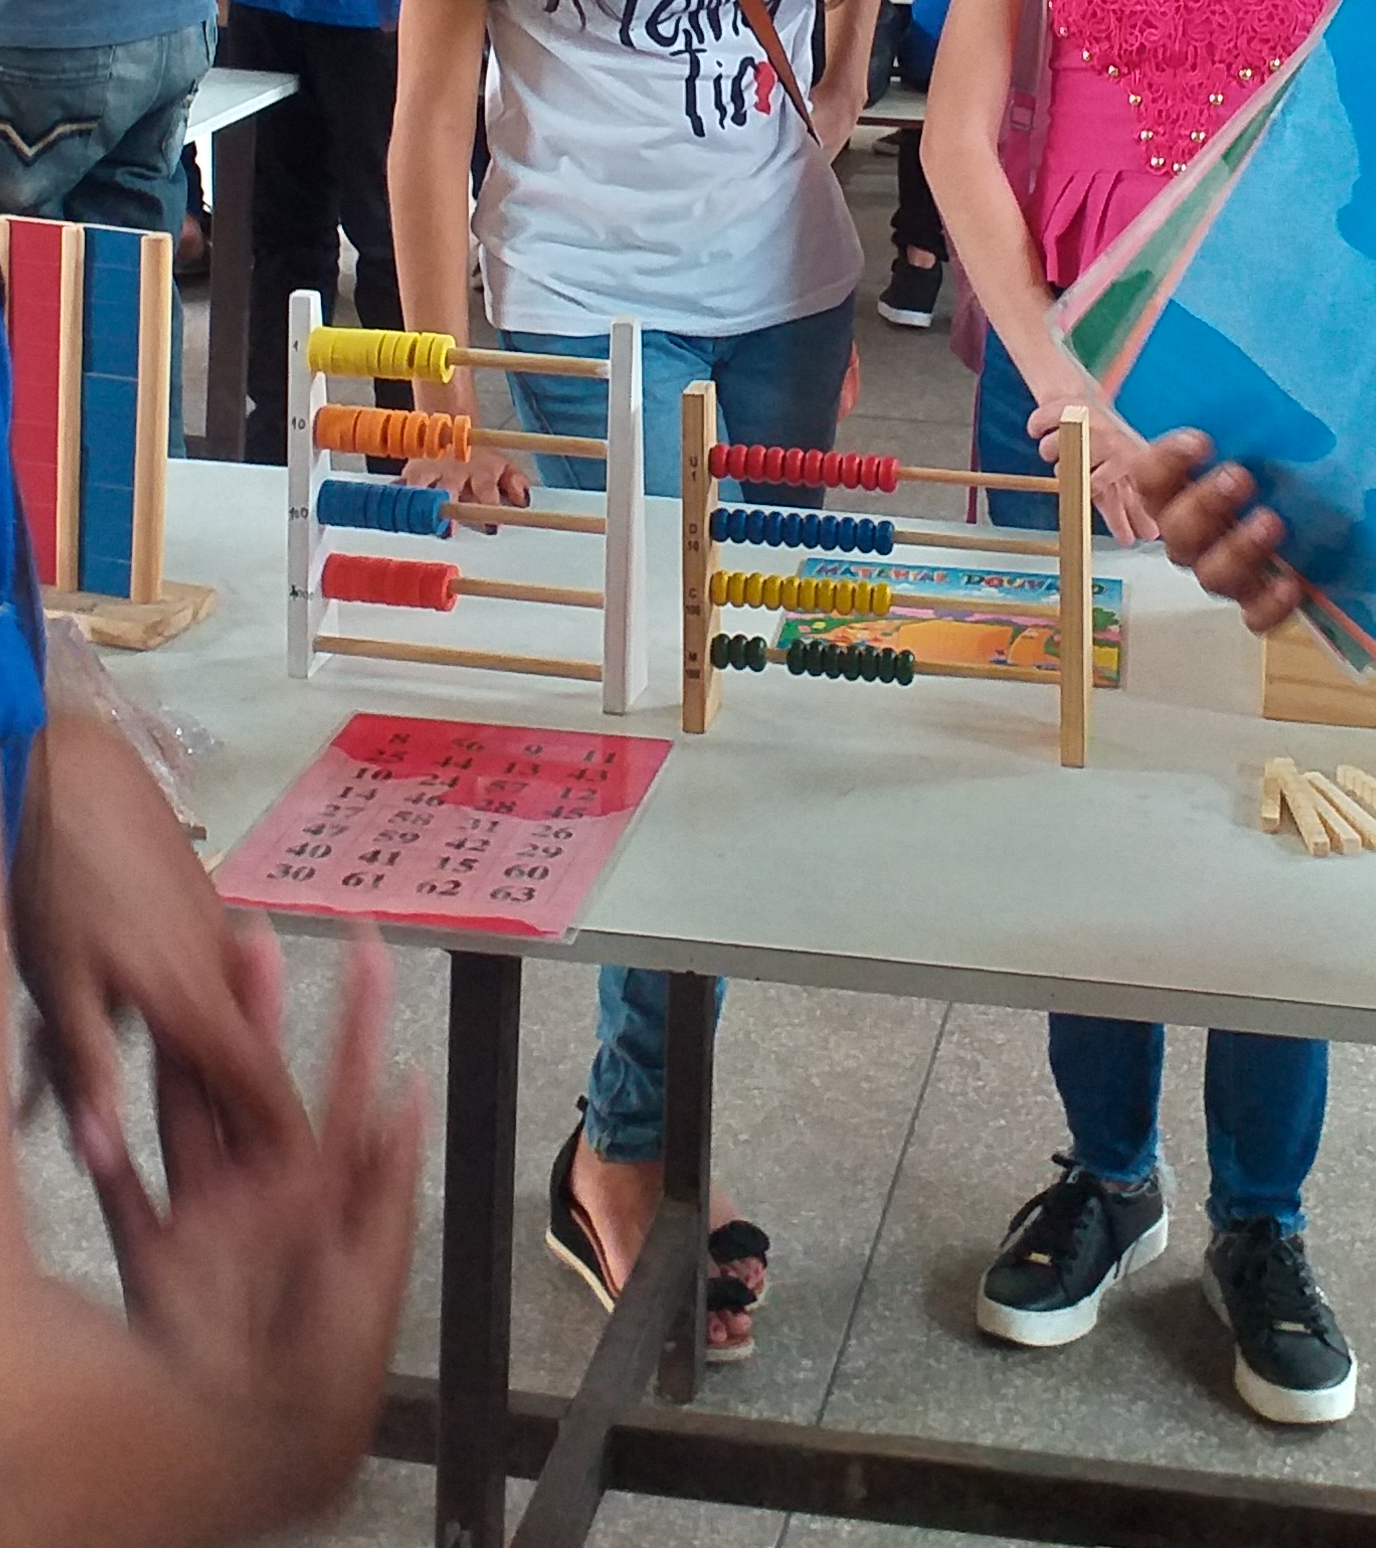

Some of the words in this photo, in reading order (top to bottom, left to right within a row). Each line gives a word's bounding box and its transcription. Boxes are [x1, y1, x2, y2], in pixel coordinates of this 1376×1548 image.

[291, 417, 307, 430] 10
[353, 767, 392, 780] 10
[337, 786, 378, 801] 14
[403, 791, 445, 807] 46
[302, 821, 348, 836] 47
[372, 829, 420, 844] 59
[445, 836, 491, 851] 42
[515, 842, 563, 859] 29
[530, 824, 573, 840] 26
[284, 841, 333, 858] 40
[357, 849, 402, 866] 41
[434, 855, 480, 873] 15
[503, 862, 549, 880] 60
[266, 863, 316, 882] 30
[342, 871, 386, 889] 61
[489, 885, 536, 902] 63
